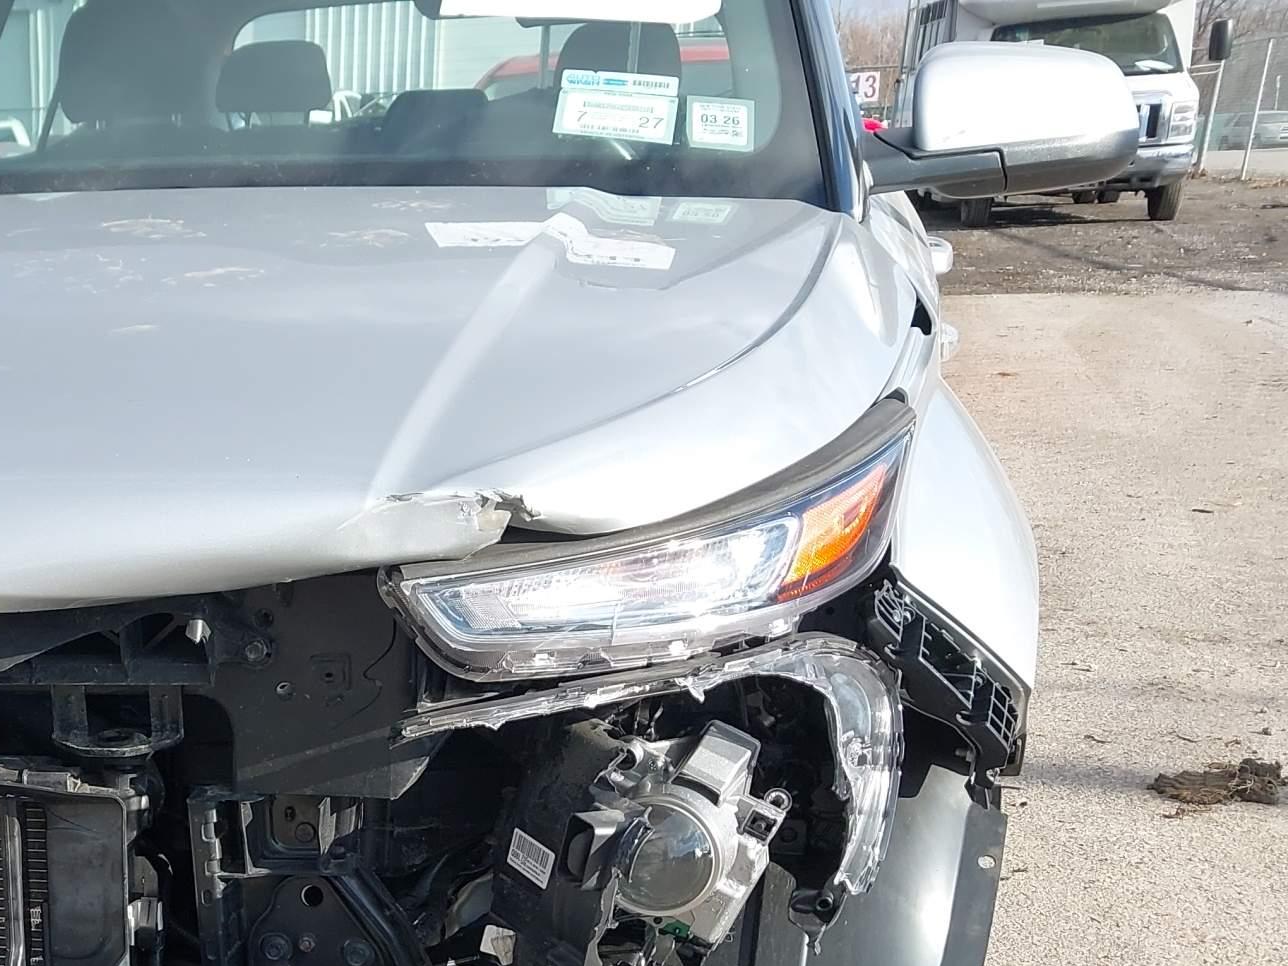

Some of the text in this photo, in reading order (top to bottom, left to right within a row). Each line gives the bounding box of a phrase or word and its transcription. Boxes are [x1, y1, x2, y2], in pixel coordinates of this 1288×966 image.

[638, 116, 665, 129] 27
[700, 113, 740, 126] 03 26
